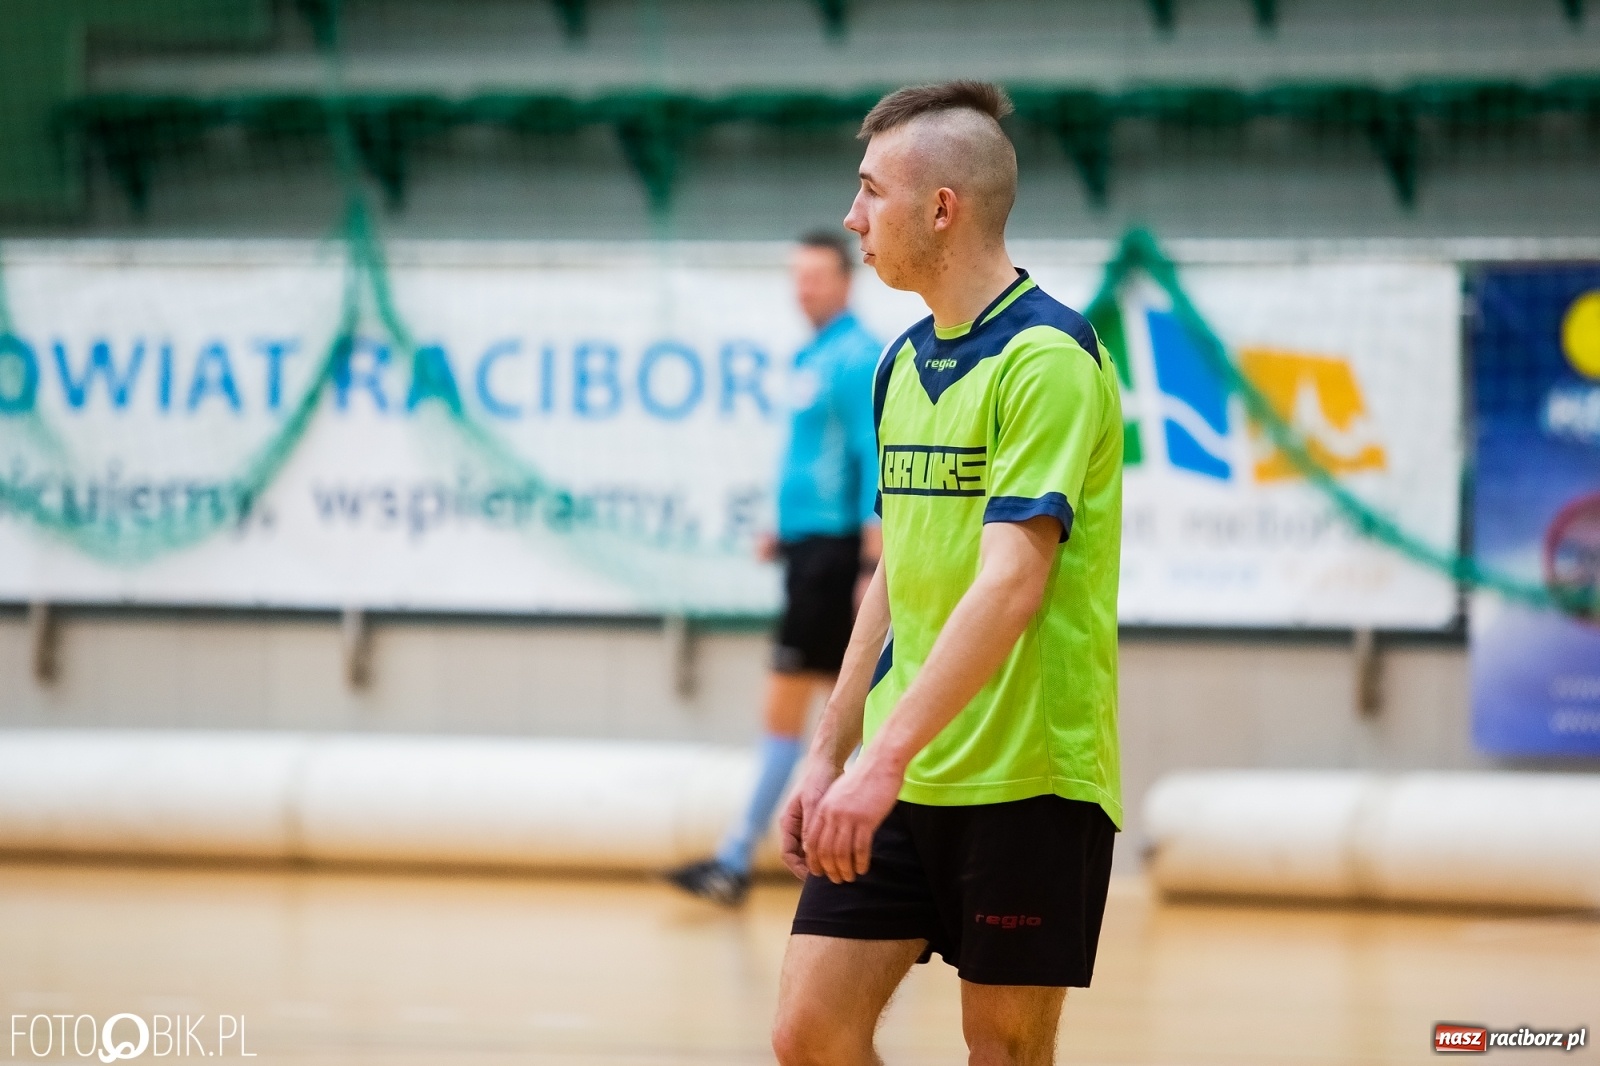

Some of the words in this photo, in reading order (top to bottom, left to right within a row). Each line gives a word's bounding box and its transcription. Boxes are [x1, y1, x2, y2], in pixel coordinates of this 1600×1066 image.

[925, 358, 958, 372] regio
[329, 338, 785, 419] RACIBOR
[975, 914, 1042, 929] regio
